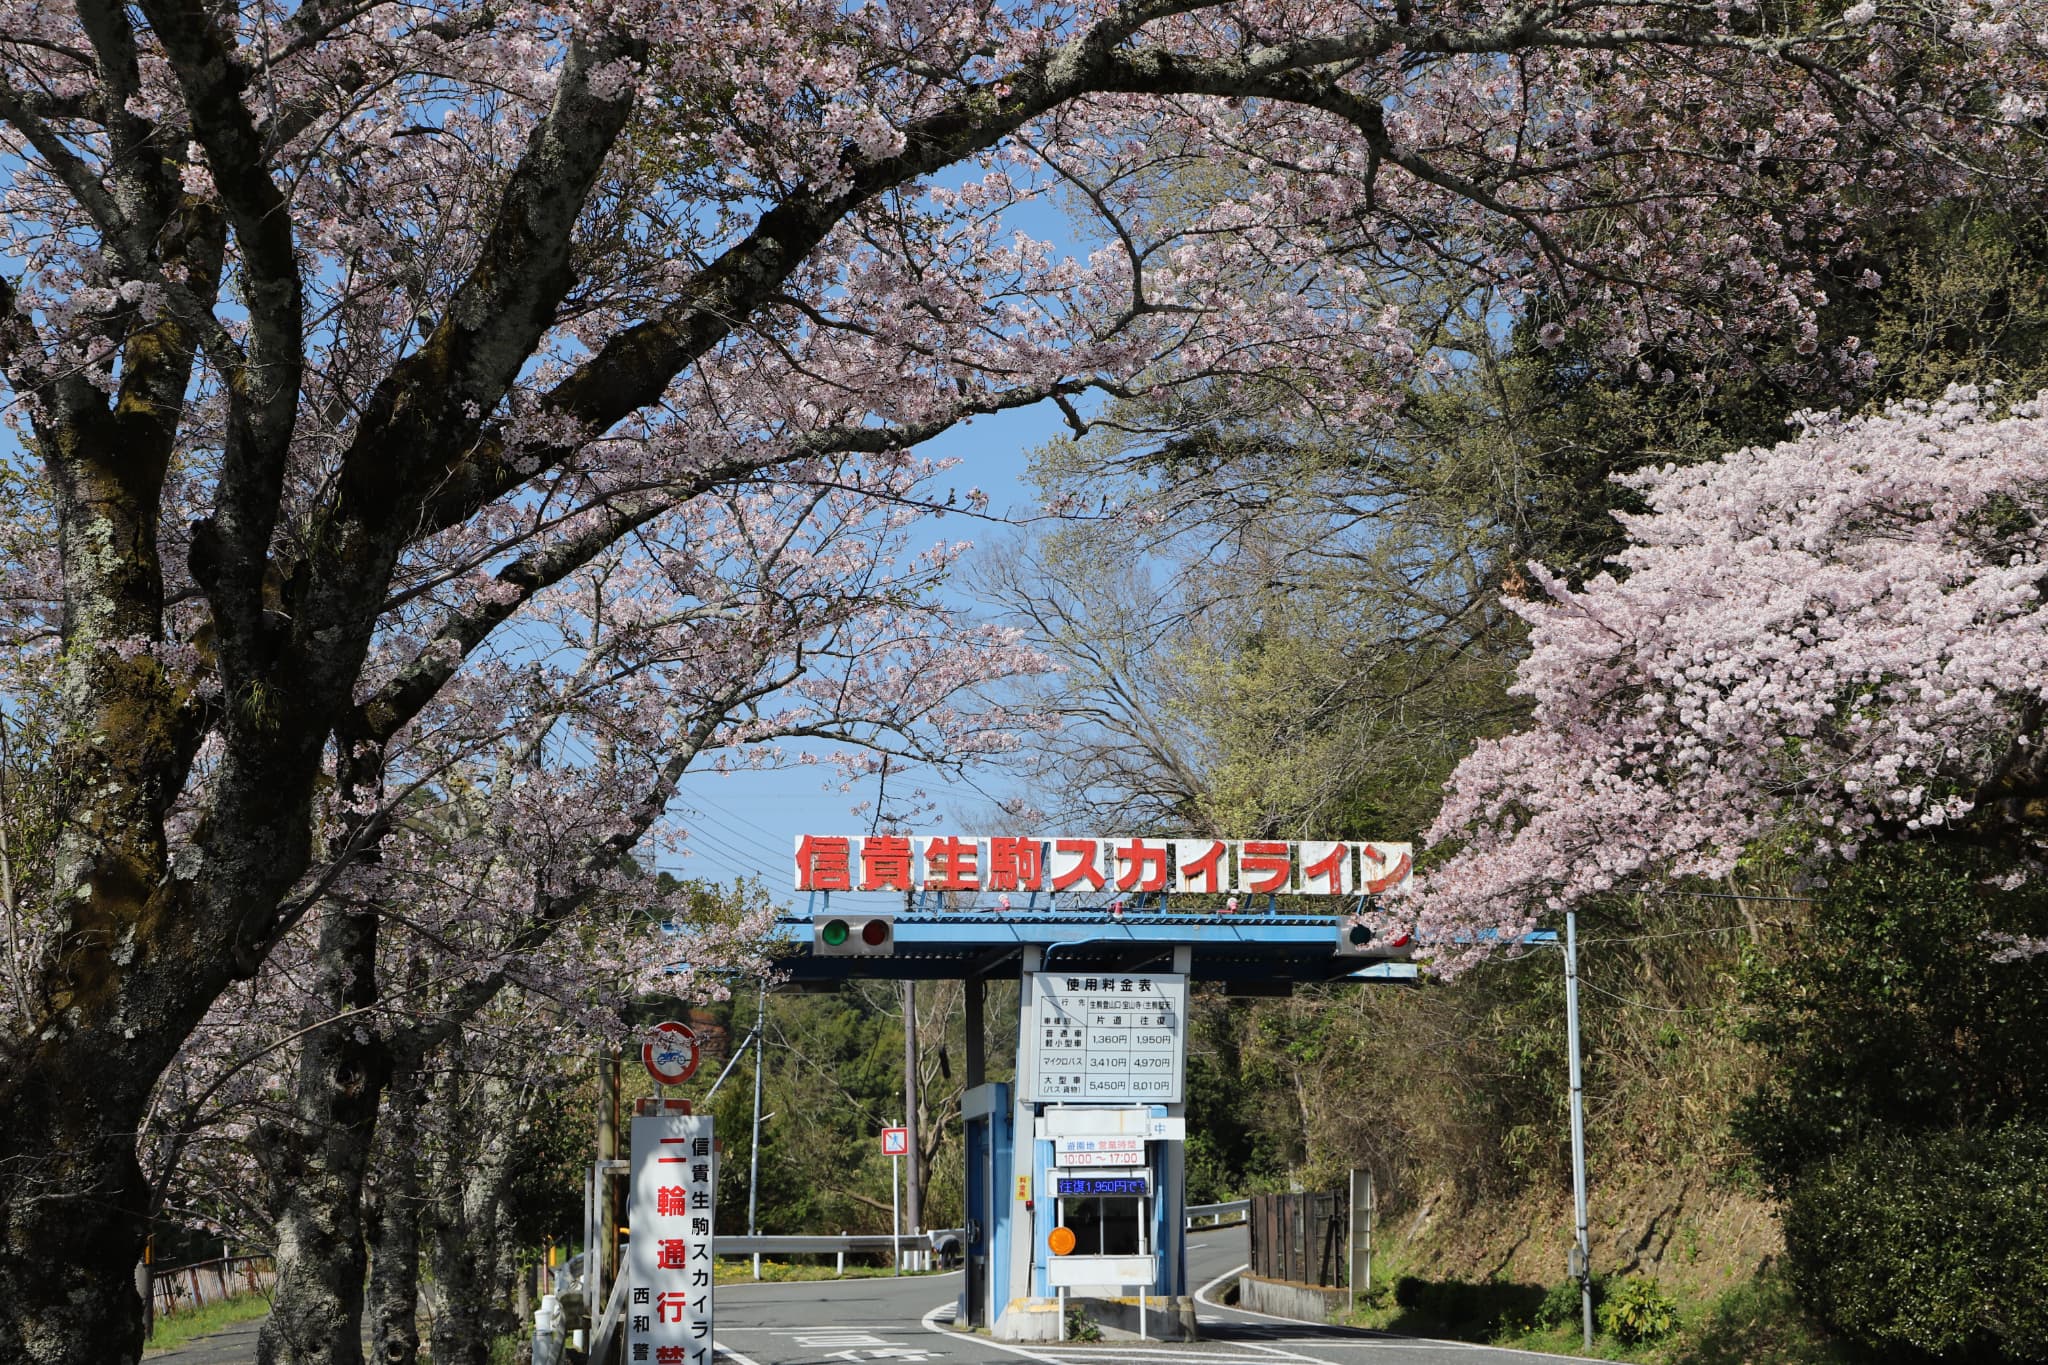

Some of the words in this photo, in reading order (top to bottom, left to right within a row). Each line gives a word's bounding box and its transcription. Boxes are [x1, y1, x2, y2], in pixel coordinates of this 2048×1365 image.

[795, 835, 1413, 895] 信貴生駒スカイライン
[1066, 978, 1152, 992] 使用料金表
[1096, 1016, 1122, 1025] 片道
[1140, 1016, 1167, 1025] 往復
[1045, 1029, 1082, 1038] 普通車
[1043, 1057, 1083, 1066] マイクロバス
[1089, 1058, 1127, 1068] 3,410円
[1134, 1058, 1170, 1068] 4,970円
[1044, 1076, 1081, 1085] 大型車
[1089, 1081, 1126, 1091] 5,450円
[633, 1288, 650, 1361] 西和警
